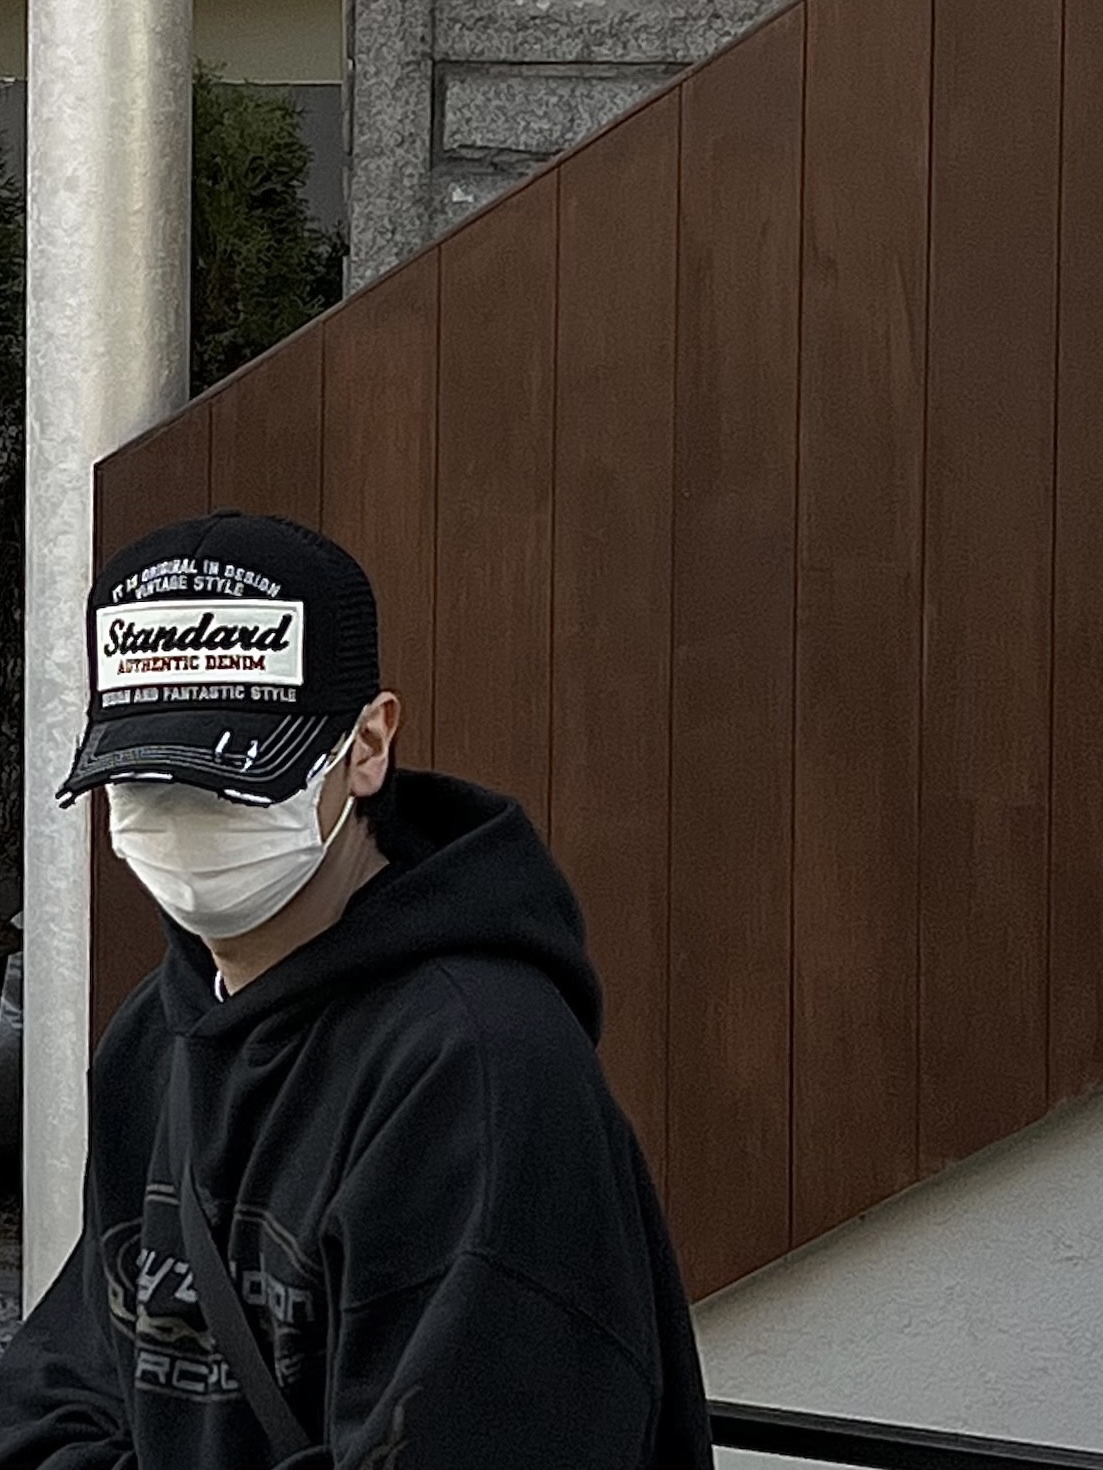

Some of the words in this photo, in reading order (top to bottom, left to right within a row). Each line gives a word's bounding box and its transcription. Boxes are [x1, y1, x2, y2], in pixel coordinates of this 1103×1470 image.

[203, 559, 220, 575] IN
[193, 575, 246, 597] STYLE
[104, 612, 293, 657] Standard
[117, 655, 200, 674] AUTHENTIC
[205, 655, 266, 671] DENIM
[163, 685, 245, 700] FANTASTIC
[250, 687, 297, 703] STYLE
